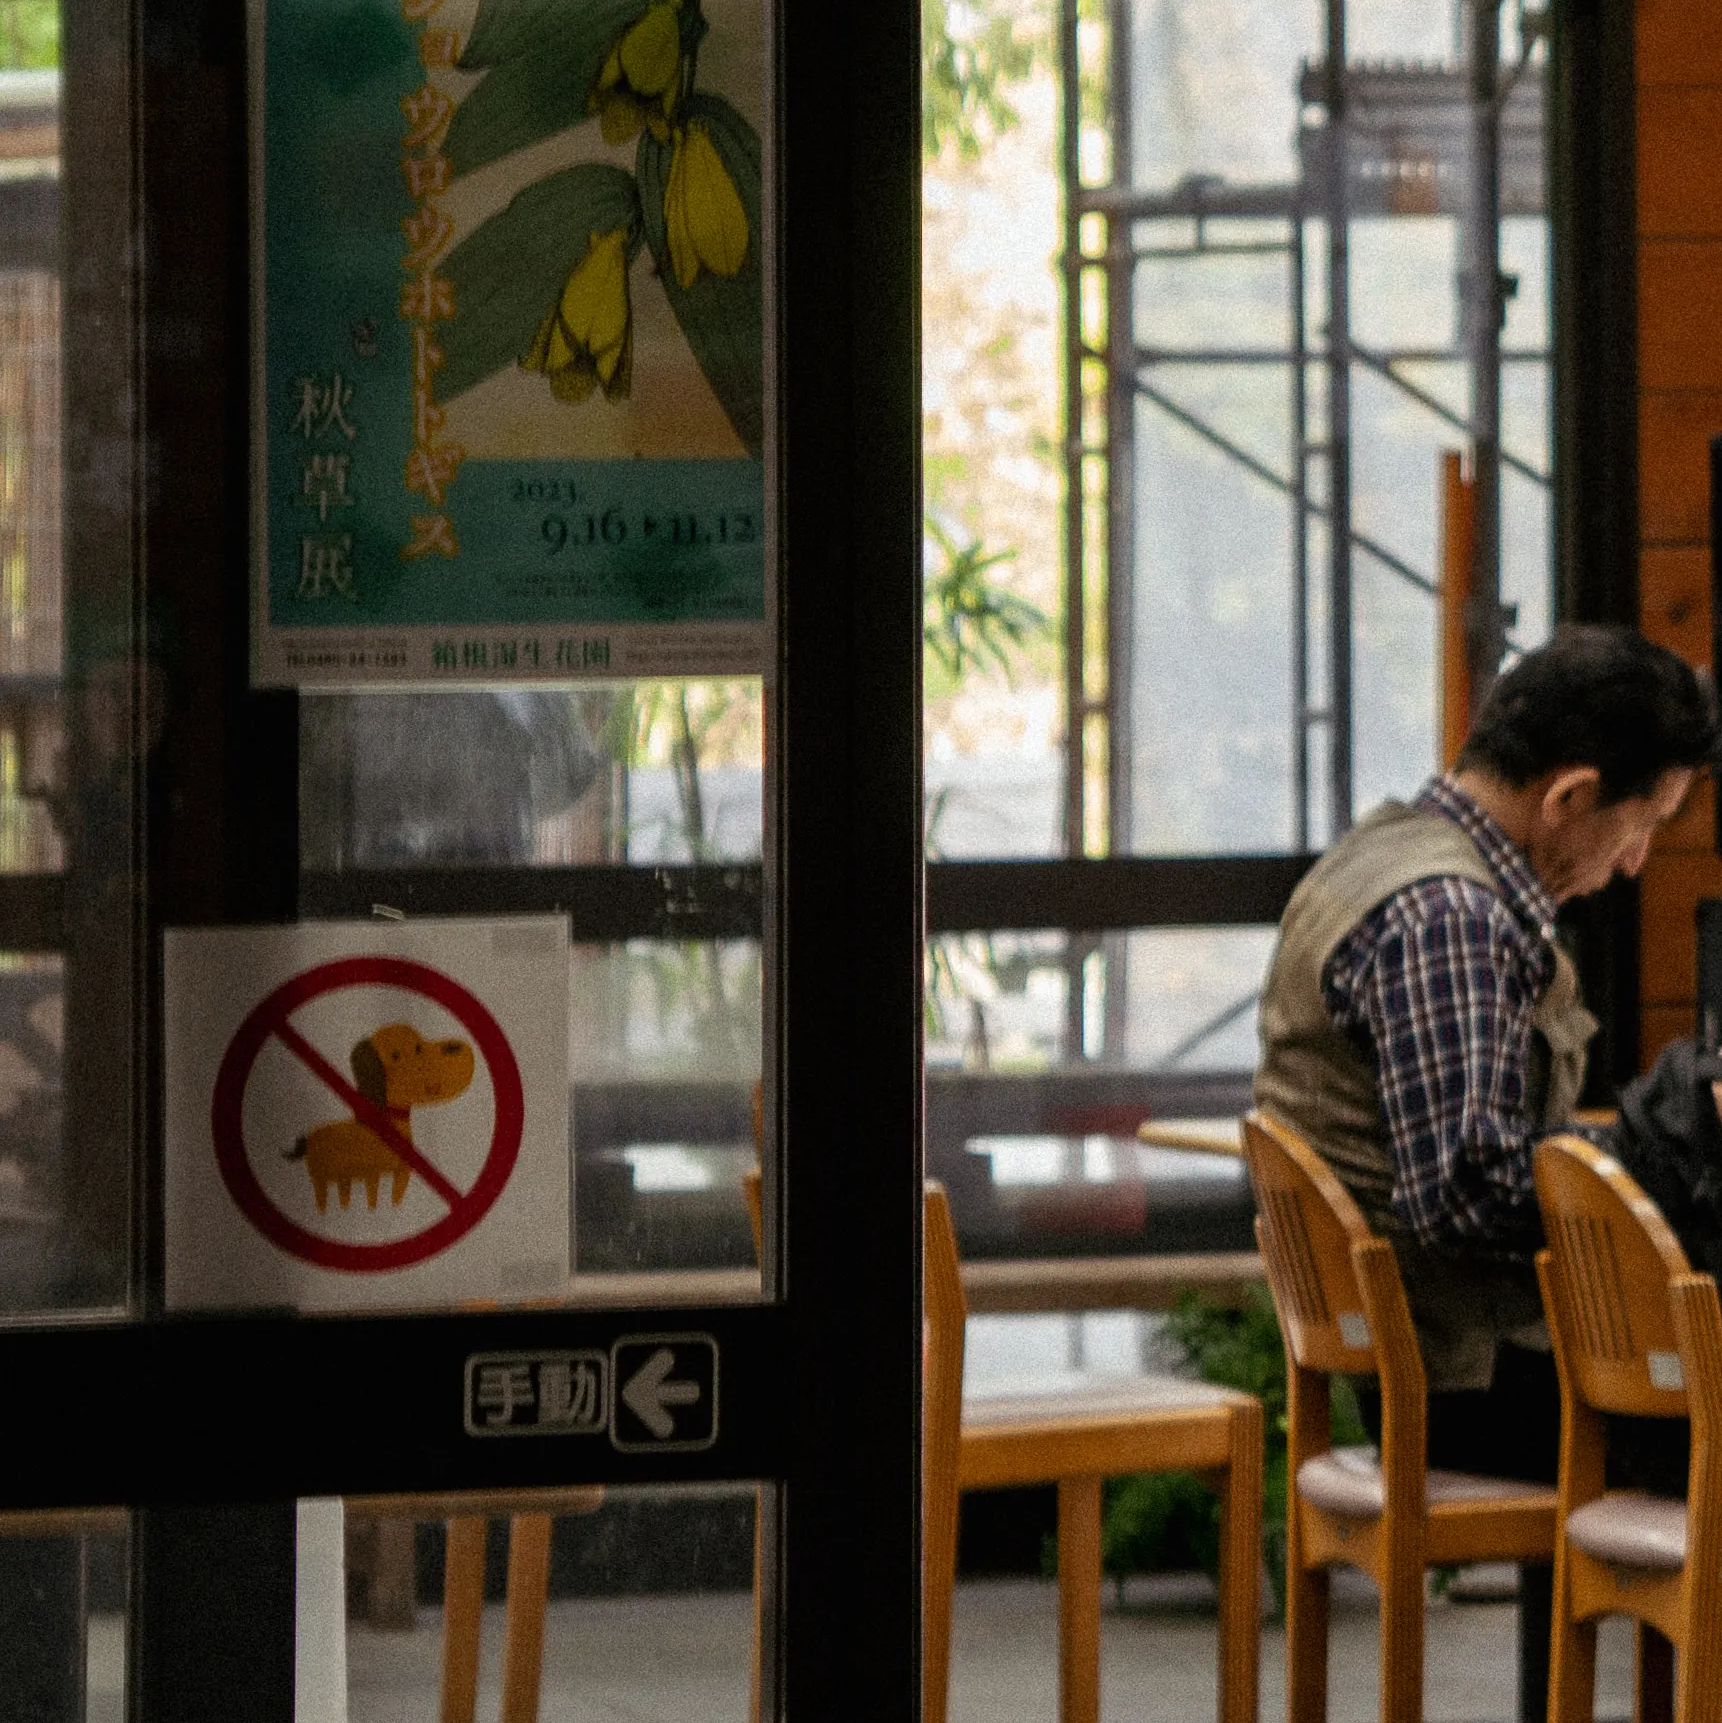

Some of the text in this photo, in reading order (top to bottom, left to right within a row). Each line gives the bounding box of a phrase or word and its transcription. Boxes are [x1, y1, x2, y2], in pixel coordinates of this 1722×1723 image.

[290, 371, 362, 602] 秋草展
[476, 1360, 597, 1428] 手動
